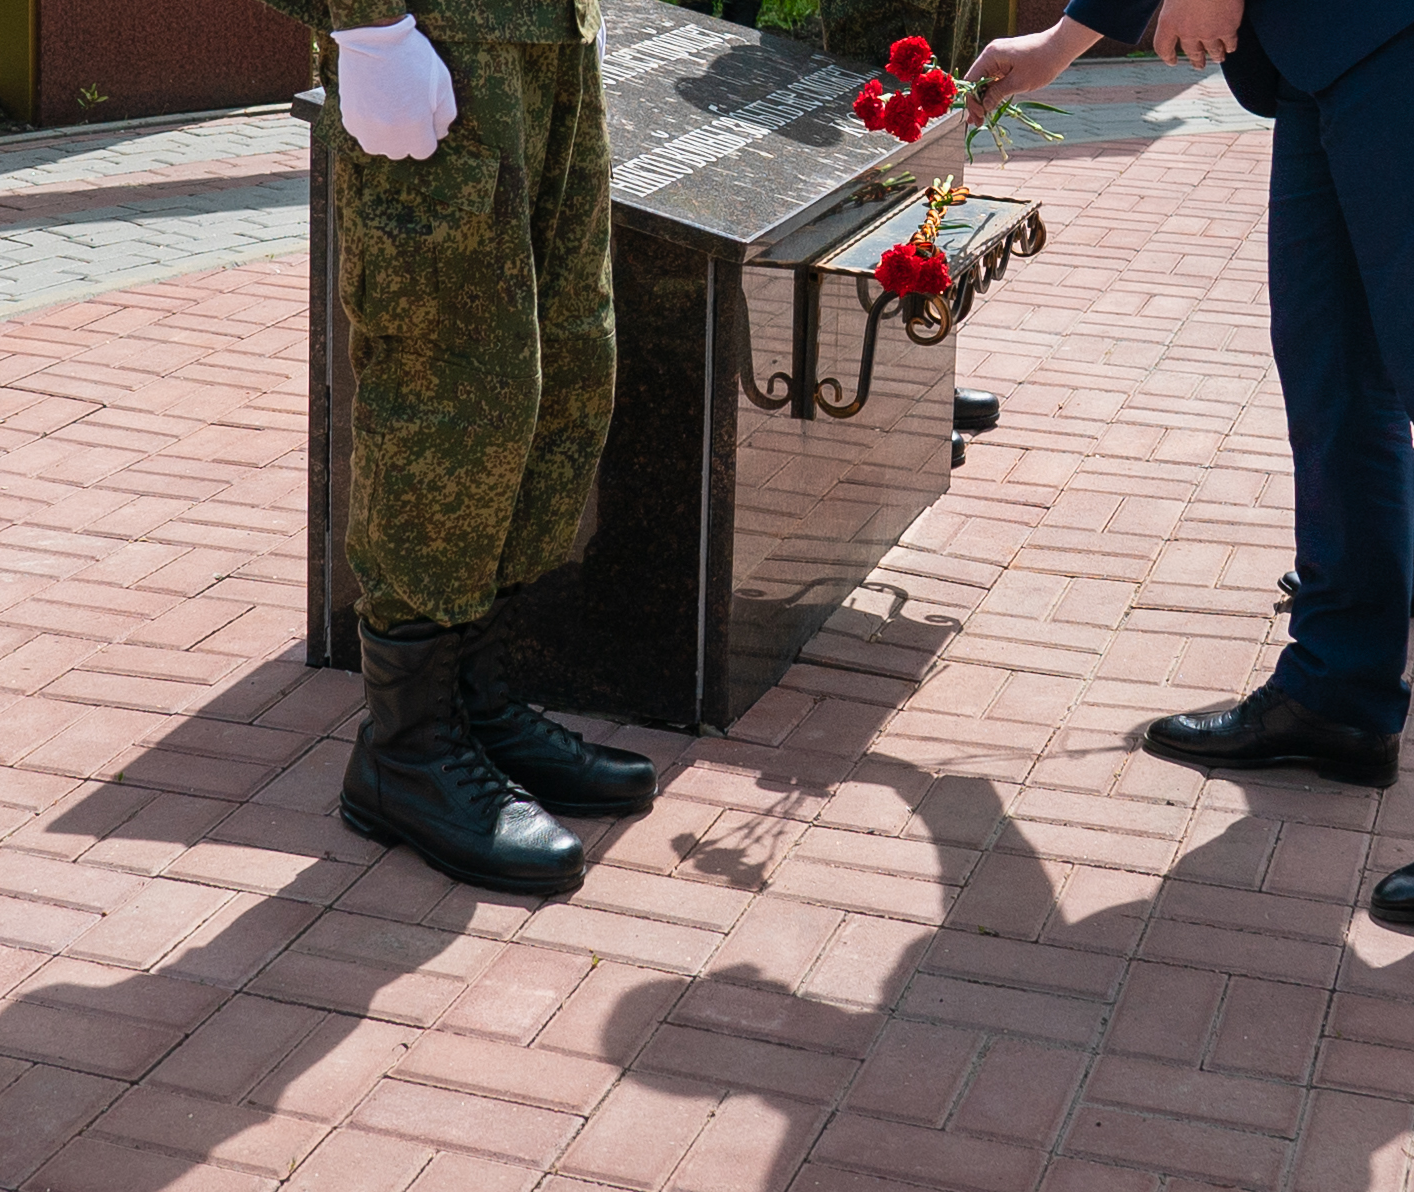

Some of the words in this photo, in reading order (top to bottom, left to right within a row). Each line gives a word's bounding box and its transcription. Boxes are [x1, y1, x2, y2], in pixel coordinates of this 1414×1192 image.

[651, 125, 755, 168] войны
[708, 98, 809, 140] забыть
[764, 89, 824, 112] не
